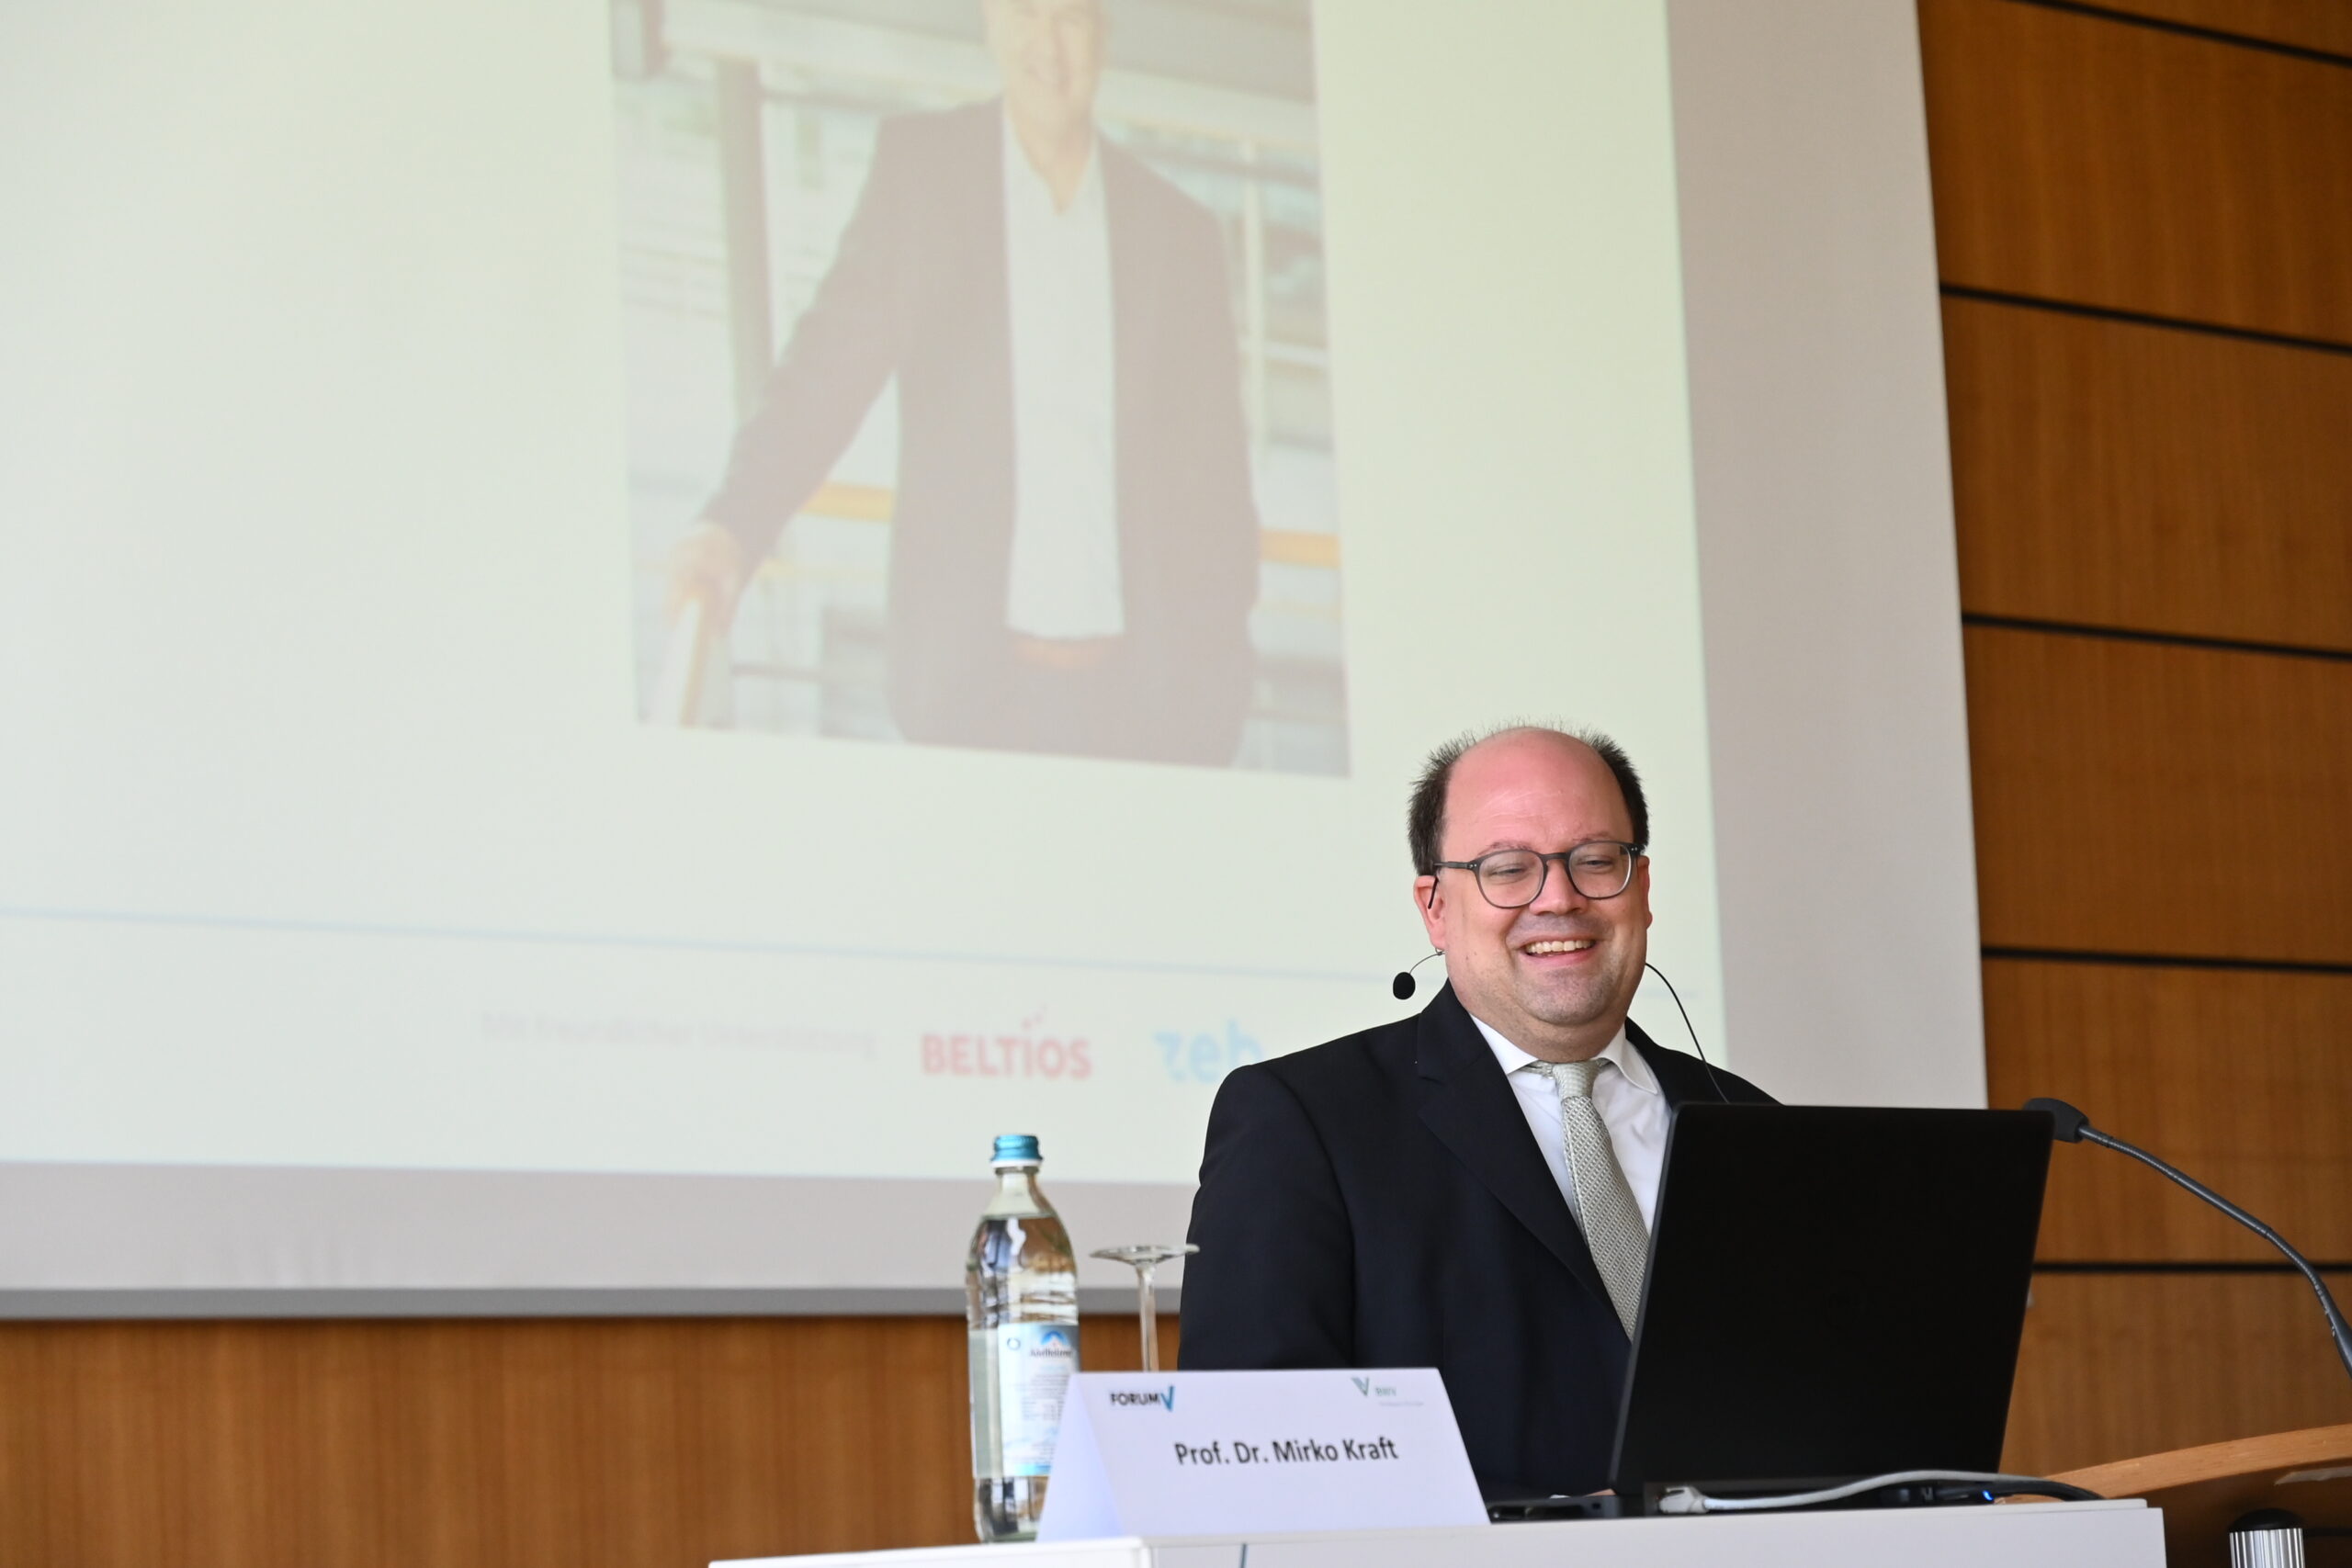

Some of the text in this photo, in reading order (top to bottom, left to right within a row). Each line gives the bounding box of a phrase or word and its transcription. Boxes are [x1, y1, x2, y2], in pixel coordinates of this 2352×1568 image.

[1174, 1437, 1399, 1466] Prof. Dr. Mirko Kraft
